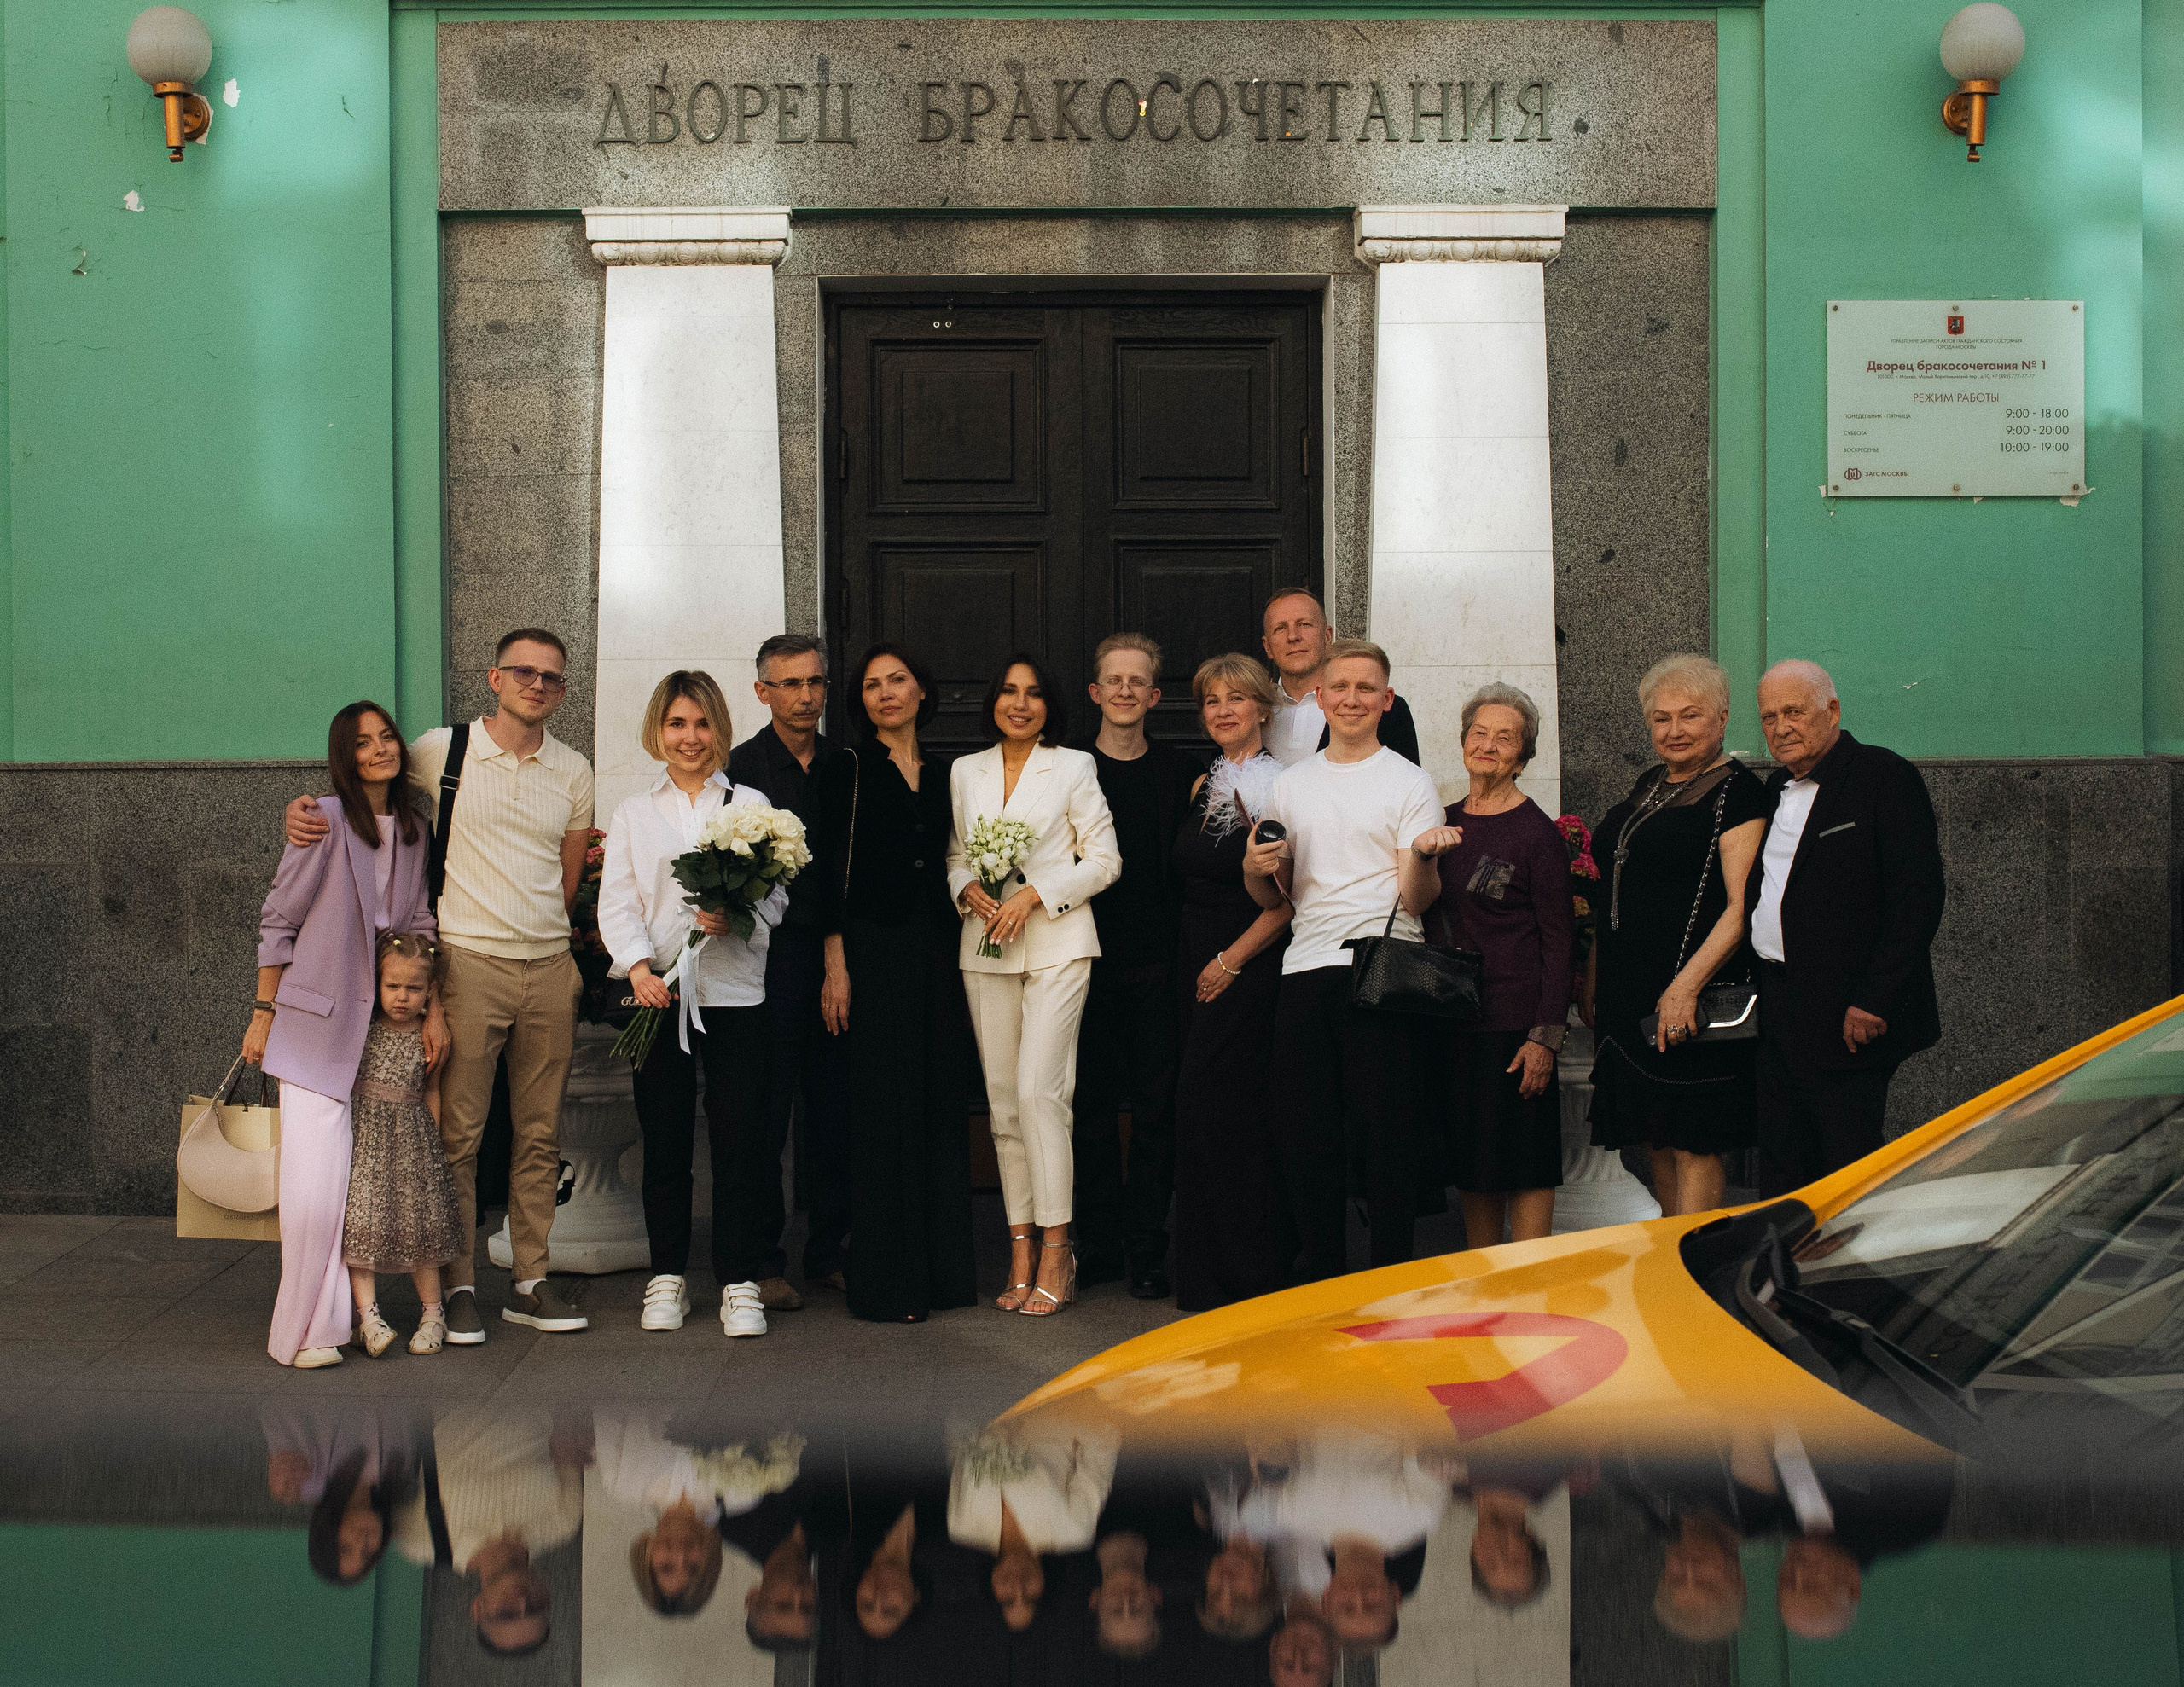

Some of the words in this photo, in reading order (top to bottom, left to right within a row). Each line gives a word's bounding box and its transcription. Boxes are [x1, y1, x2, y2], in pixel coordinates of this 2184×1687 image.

[593, 78, 857, 150] ДВОРЕЦ
[917, 77, 1553, 143] БРАКОСОЧЕТАНИЯ
[1866, 361, 1914, 373] Дворец
[1917, 360, 2018, 373] бракосочетания
[2021, 360, 2036, 370] №
[2041, 360, 2046, 370] 1
[1913, 393, 1954, 403] РЕЖИМ
[1957, 393, 1999, 403] РАБОТЫ
[2006, 409, 2030, 419] 9:00
[2041, 409, 2069, 419] 18:00
[2006, 425, 2030, 435] 9:00
[2039, 425, 2069, 435] 20:00
[2000, 442, 2030, 452] 10:00
[2040, 442, 2069, 452] 19:00
